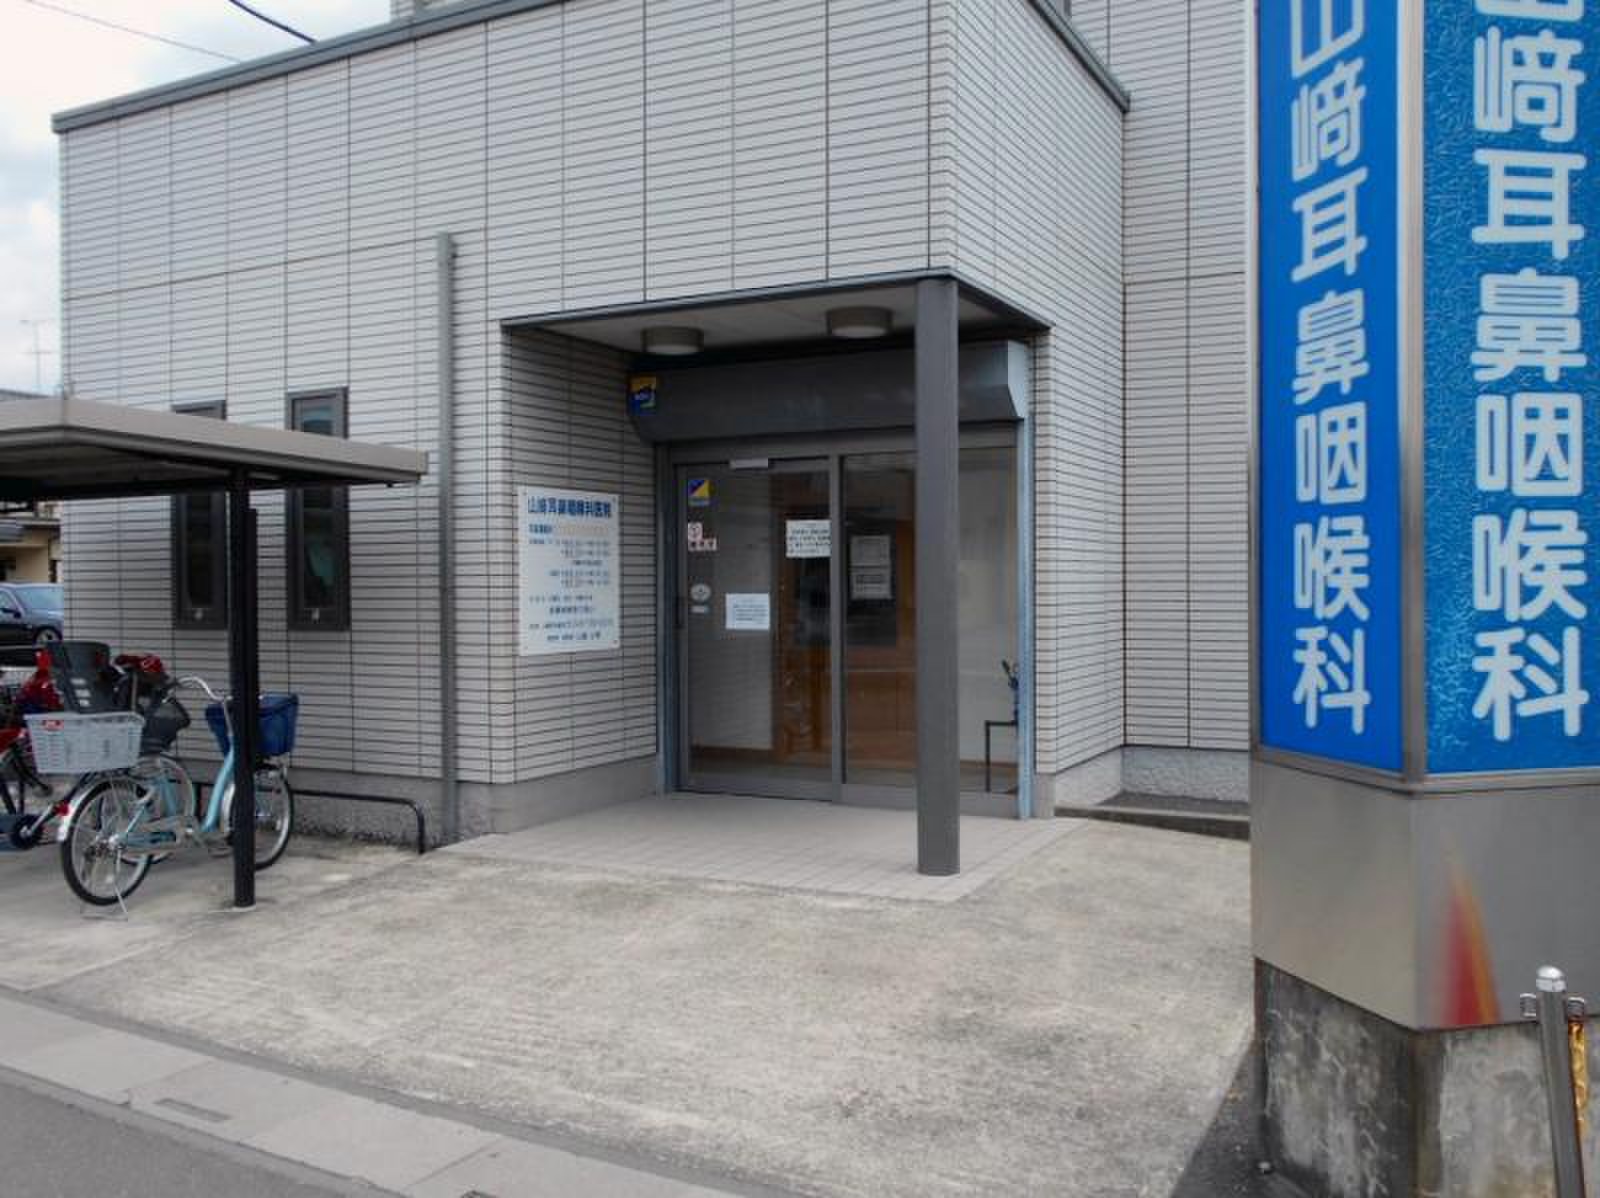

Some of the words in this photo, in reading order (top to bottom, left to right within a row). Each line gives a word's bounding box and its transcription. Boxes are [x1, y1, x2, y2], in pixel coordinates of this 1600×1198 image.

[1470, 0, 1589, 742] 﨑耳鼻咽喉科
